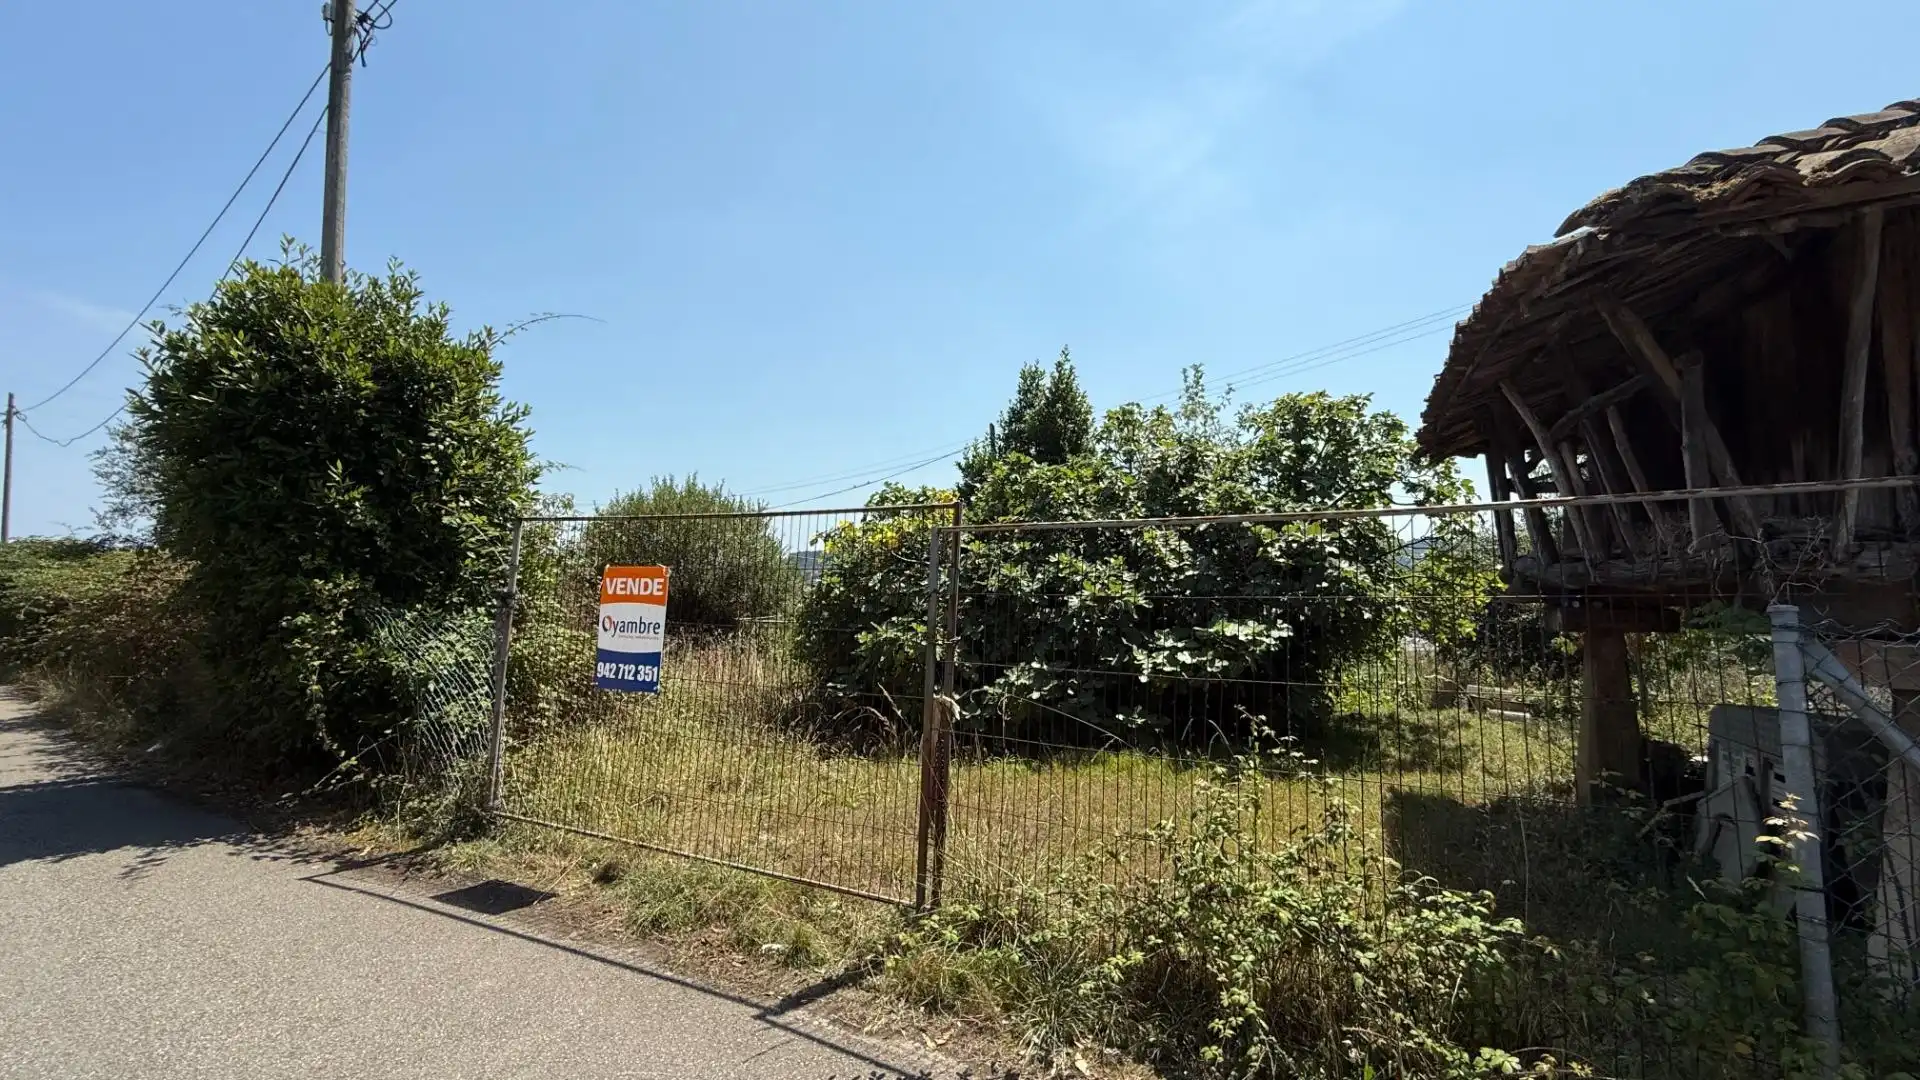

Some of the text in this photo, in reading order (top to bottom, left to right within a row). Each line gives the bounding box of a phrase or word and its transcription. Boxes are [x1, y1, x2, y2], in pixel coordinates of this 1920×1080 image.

[606, 578, 664, 595] VENDE
[602, 615, 660, 637] Oyambre
[597, 662, 657, 682] 942 712 351
